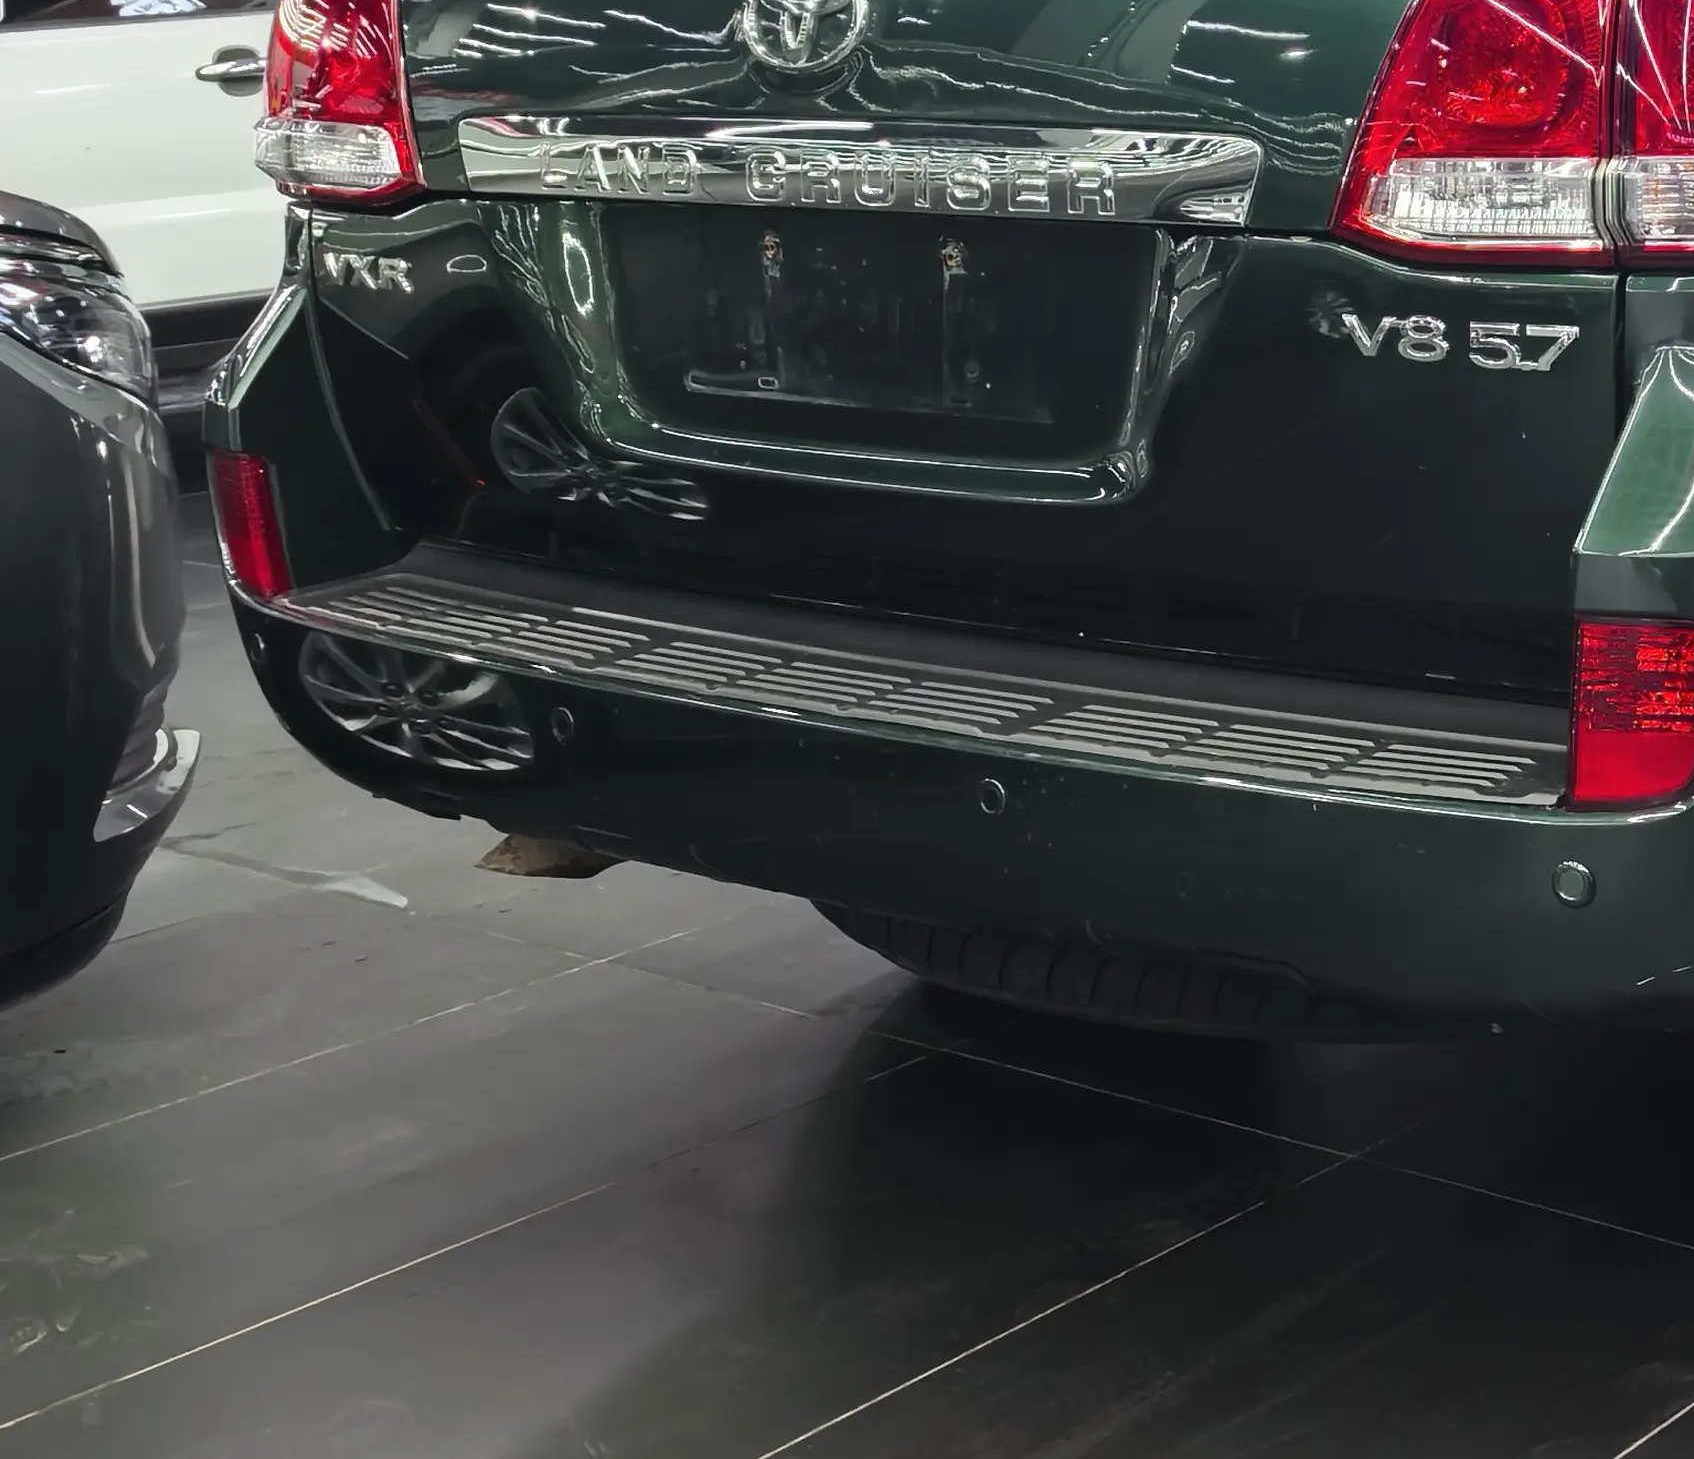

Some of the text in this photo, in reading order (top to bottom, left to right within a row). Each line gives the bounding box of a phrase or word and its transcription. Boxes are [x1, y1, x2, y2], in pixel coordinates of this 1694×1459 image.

[540, 142, 1117, 216] LAND CRUISER
[323, 252, 414, 294] VXR
[1341, 314, 1450, 362] V8
